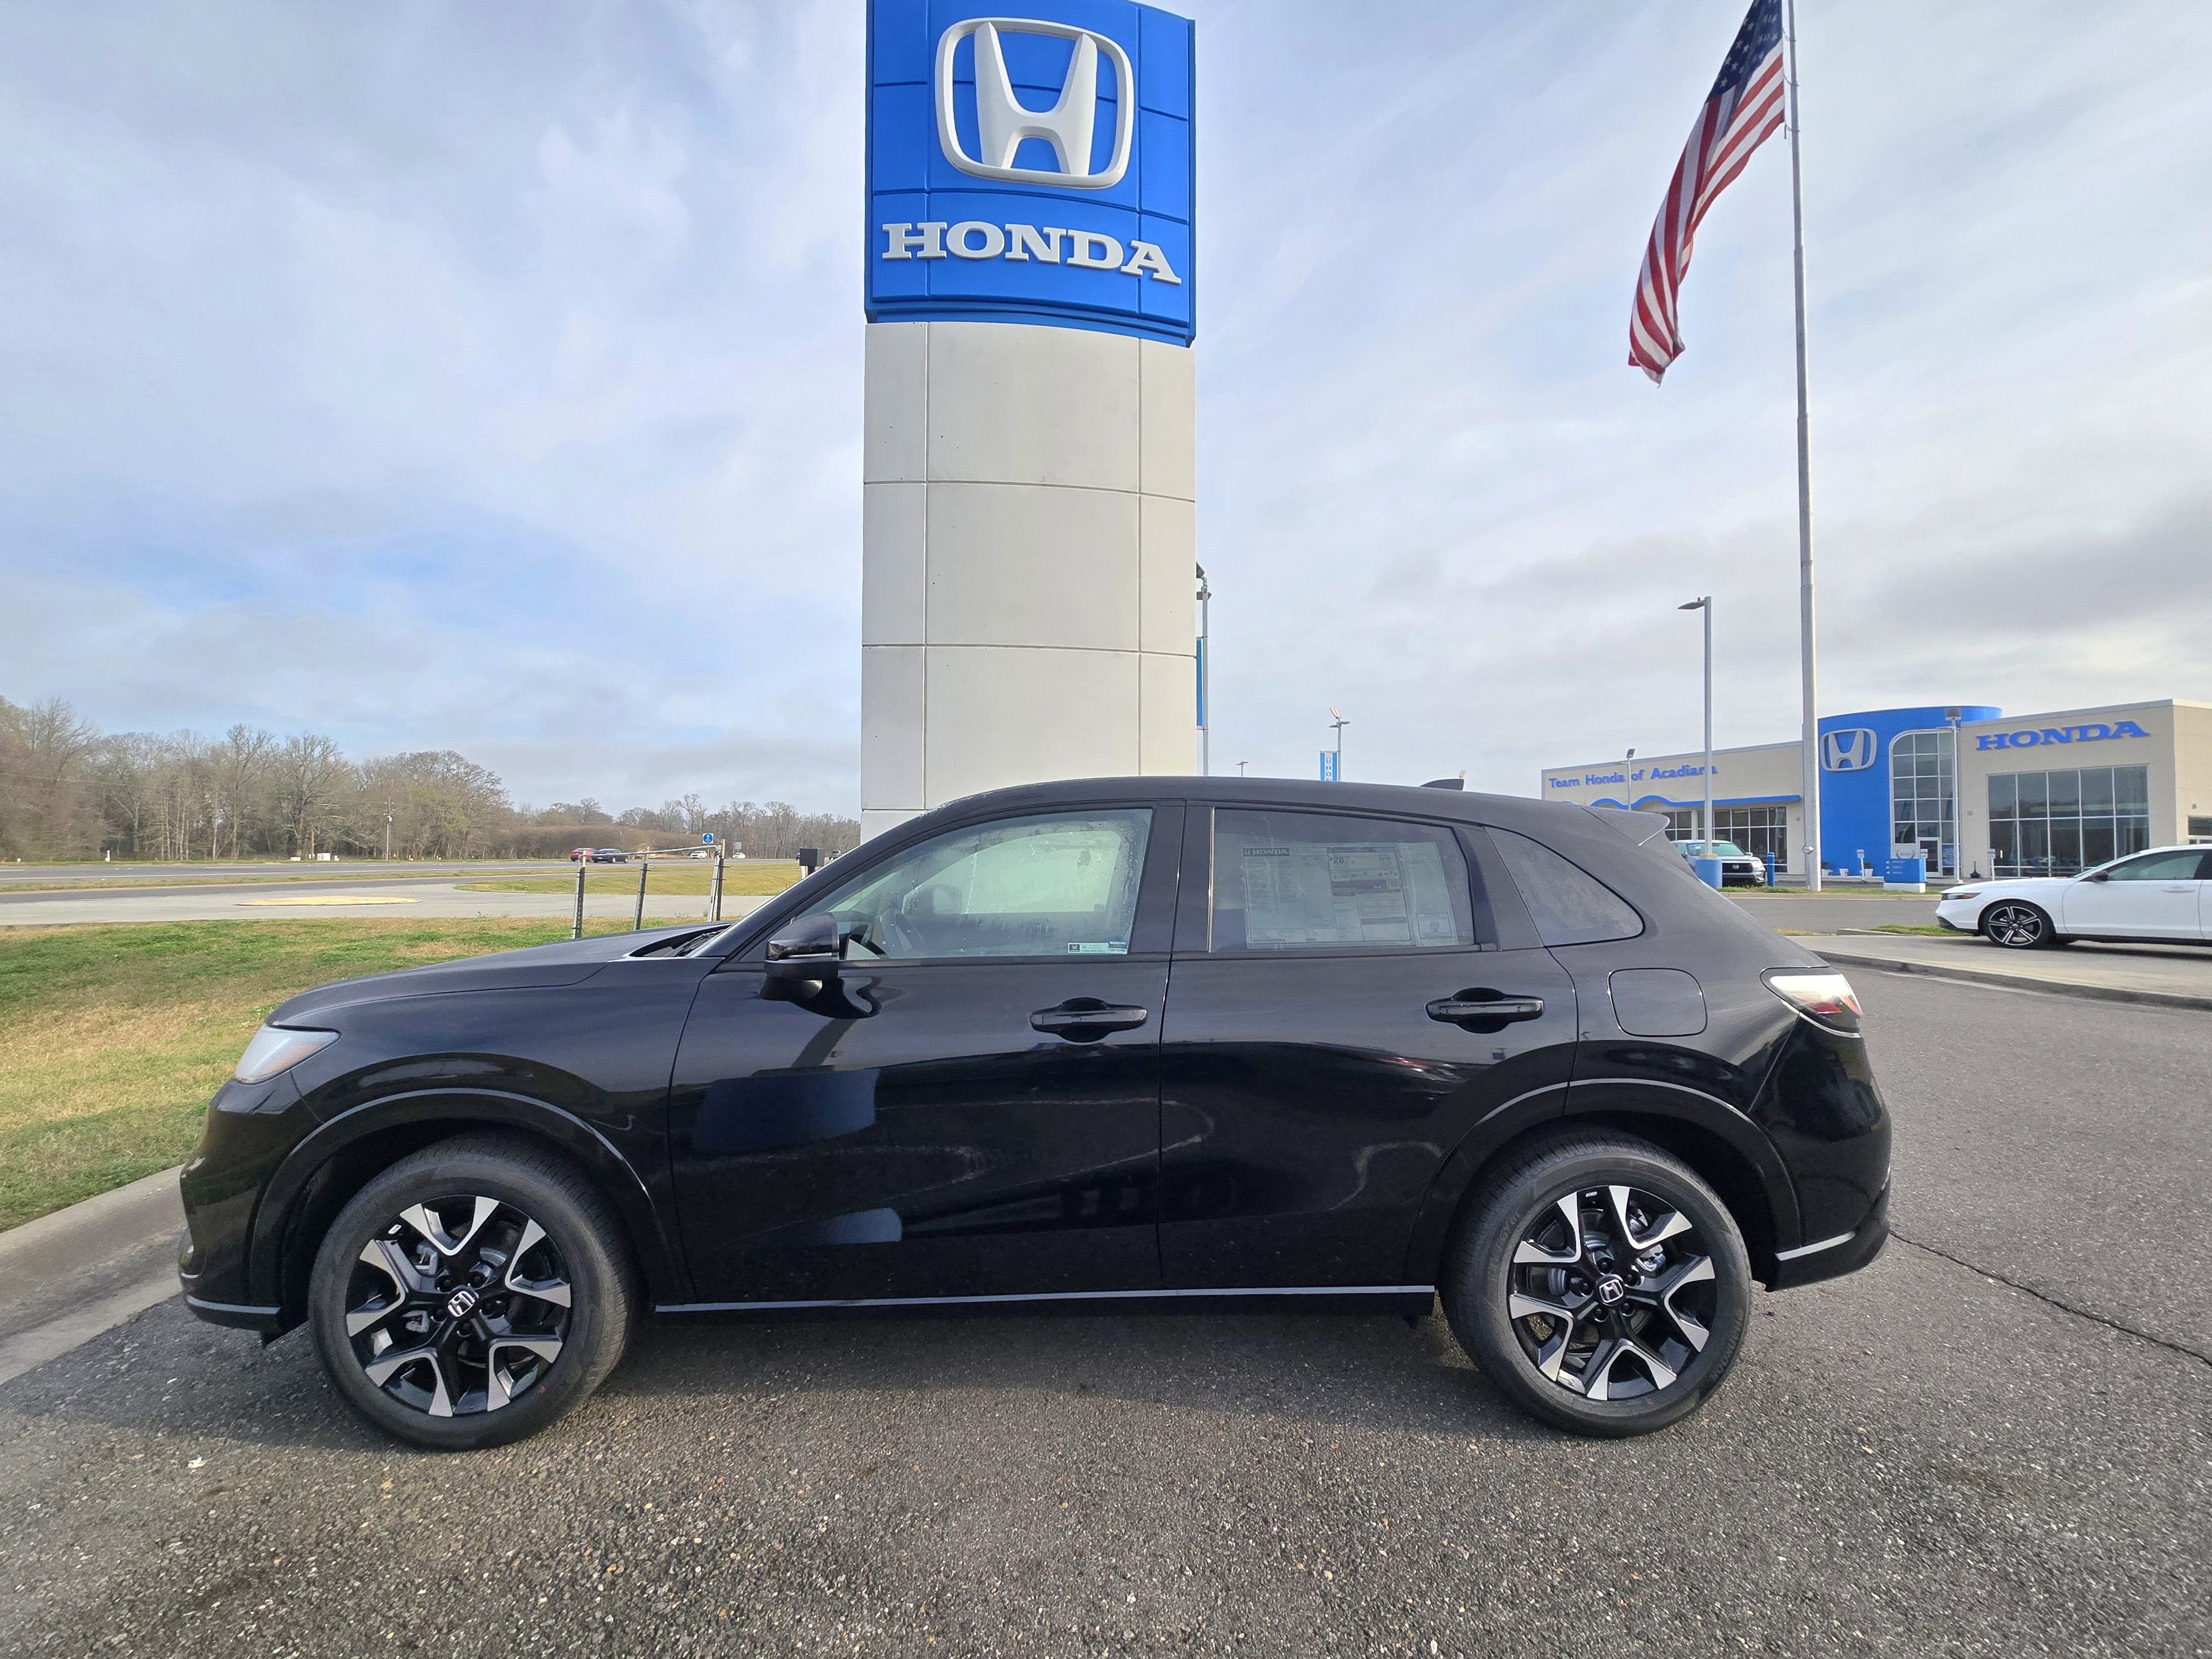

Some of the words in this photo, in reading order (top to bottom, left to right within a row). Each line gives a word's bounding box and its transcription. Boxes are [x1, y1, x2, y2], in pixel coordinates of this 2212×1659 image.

[882, 221, 1181, 286] HONDA
[1975, 721, 2150, 751] HONDA
[1548, 778, 1580, 788] Team
[1585, 772, 1625, 785] Honda
[1631, 769, 1645, 781] of
